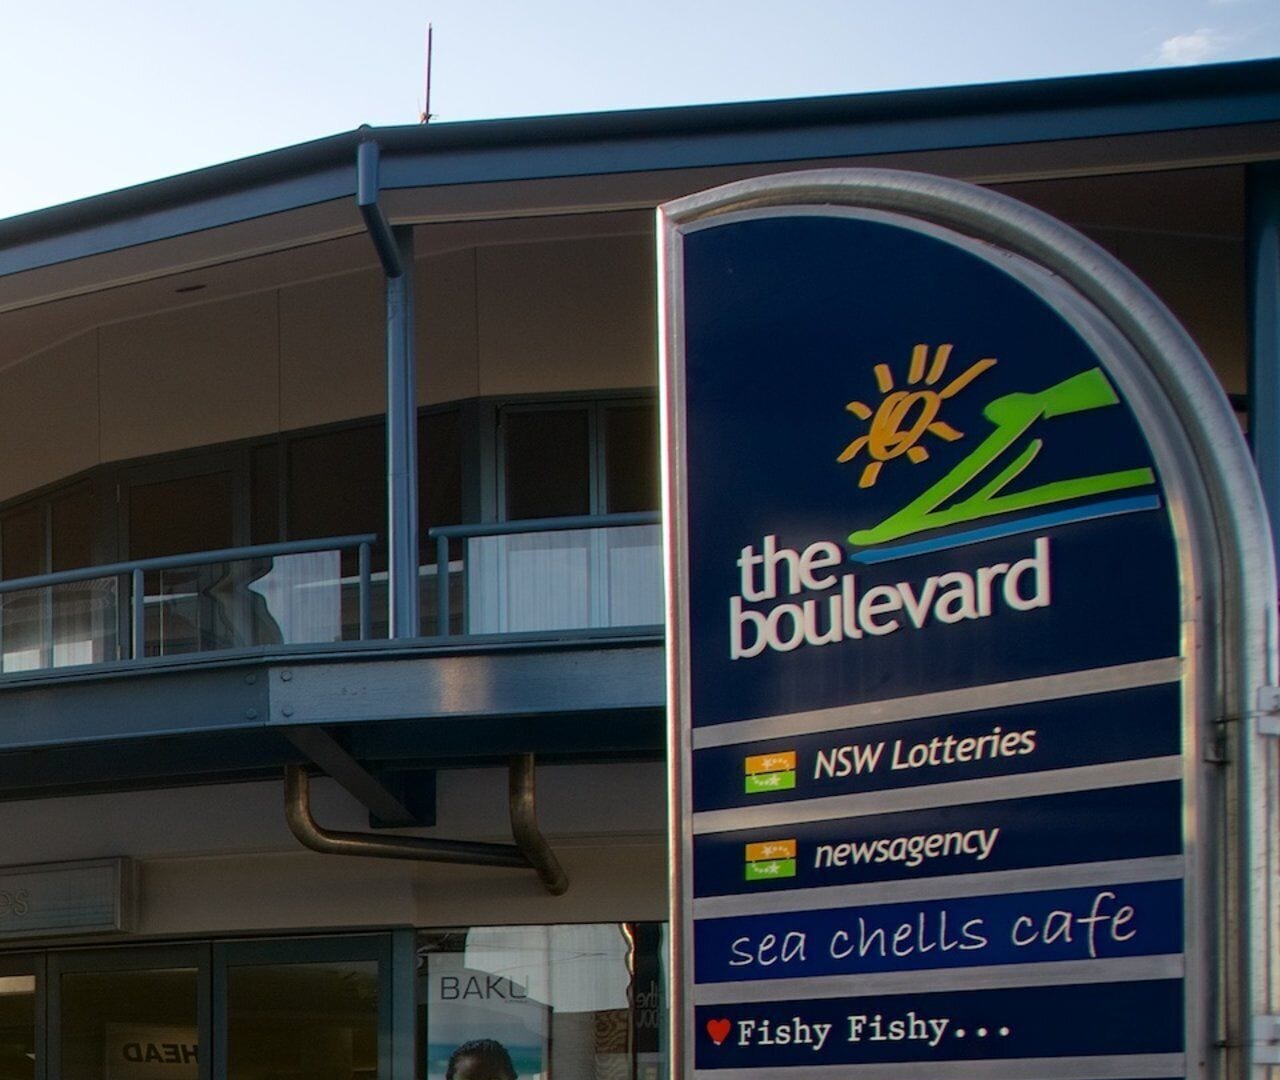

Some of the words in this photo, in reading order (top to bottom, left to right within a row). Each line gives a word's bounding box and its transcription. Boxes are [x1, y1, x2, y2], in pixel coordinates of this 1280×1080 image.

[737, 534, 843, 603] the
[729, 537, 1052, 661] boulevard
[814, 742, 884, 780] NSW
[891, 726, 1038, 772] Lotteries
[814, 826, 1000, 870] newsagency
[729, 930, 807, 968] sea
[829, 911, 989, 960] chells
[1011, 891, 1138, 959] cafe
[441, 975, 528, 1000] BAKU
[737, 1017, 833, 1051] Fishy
